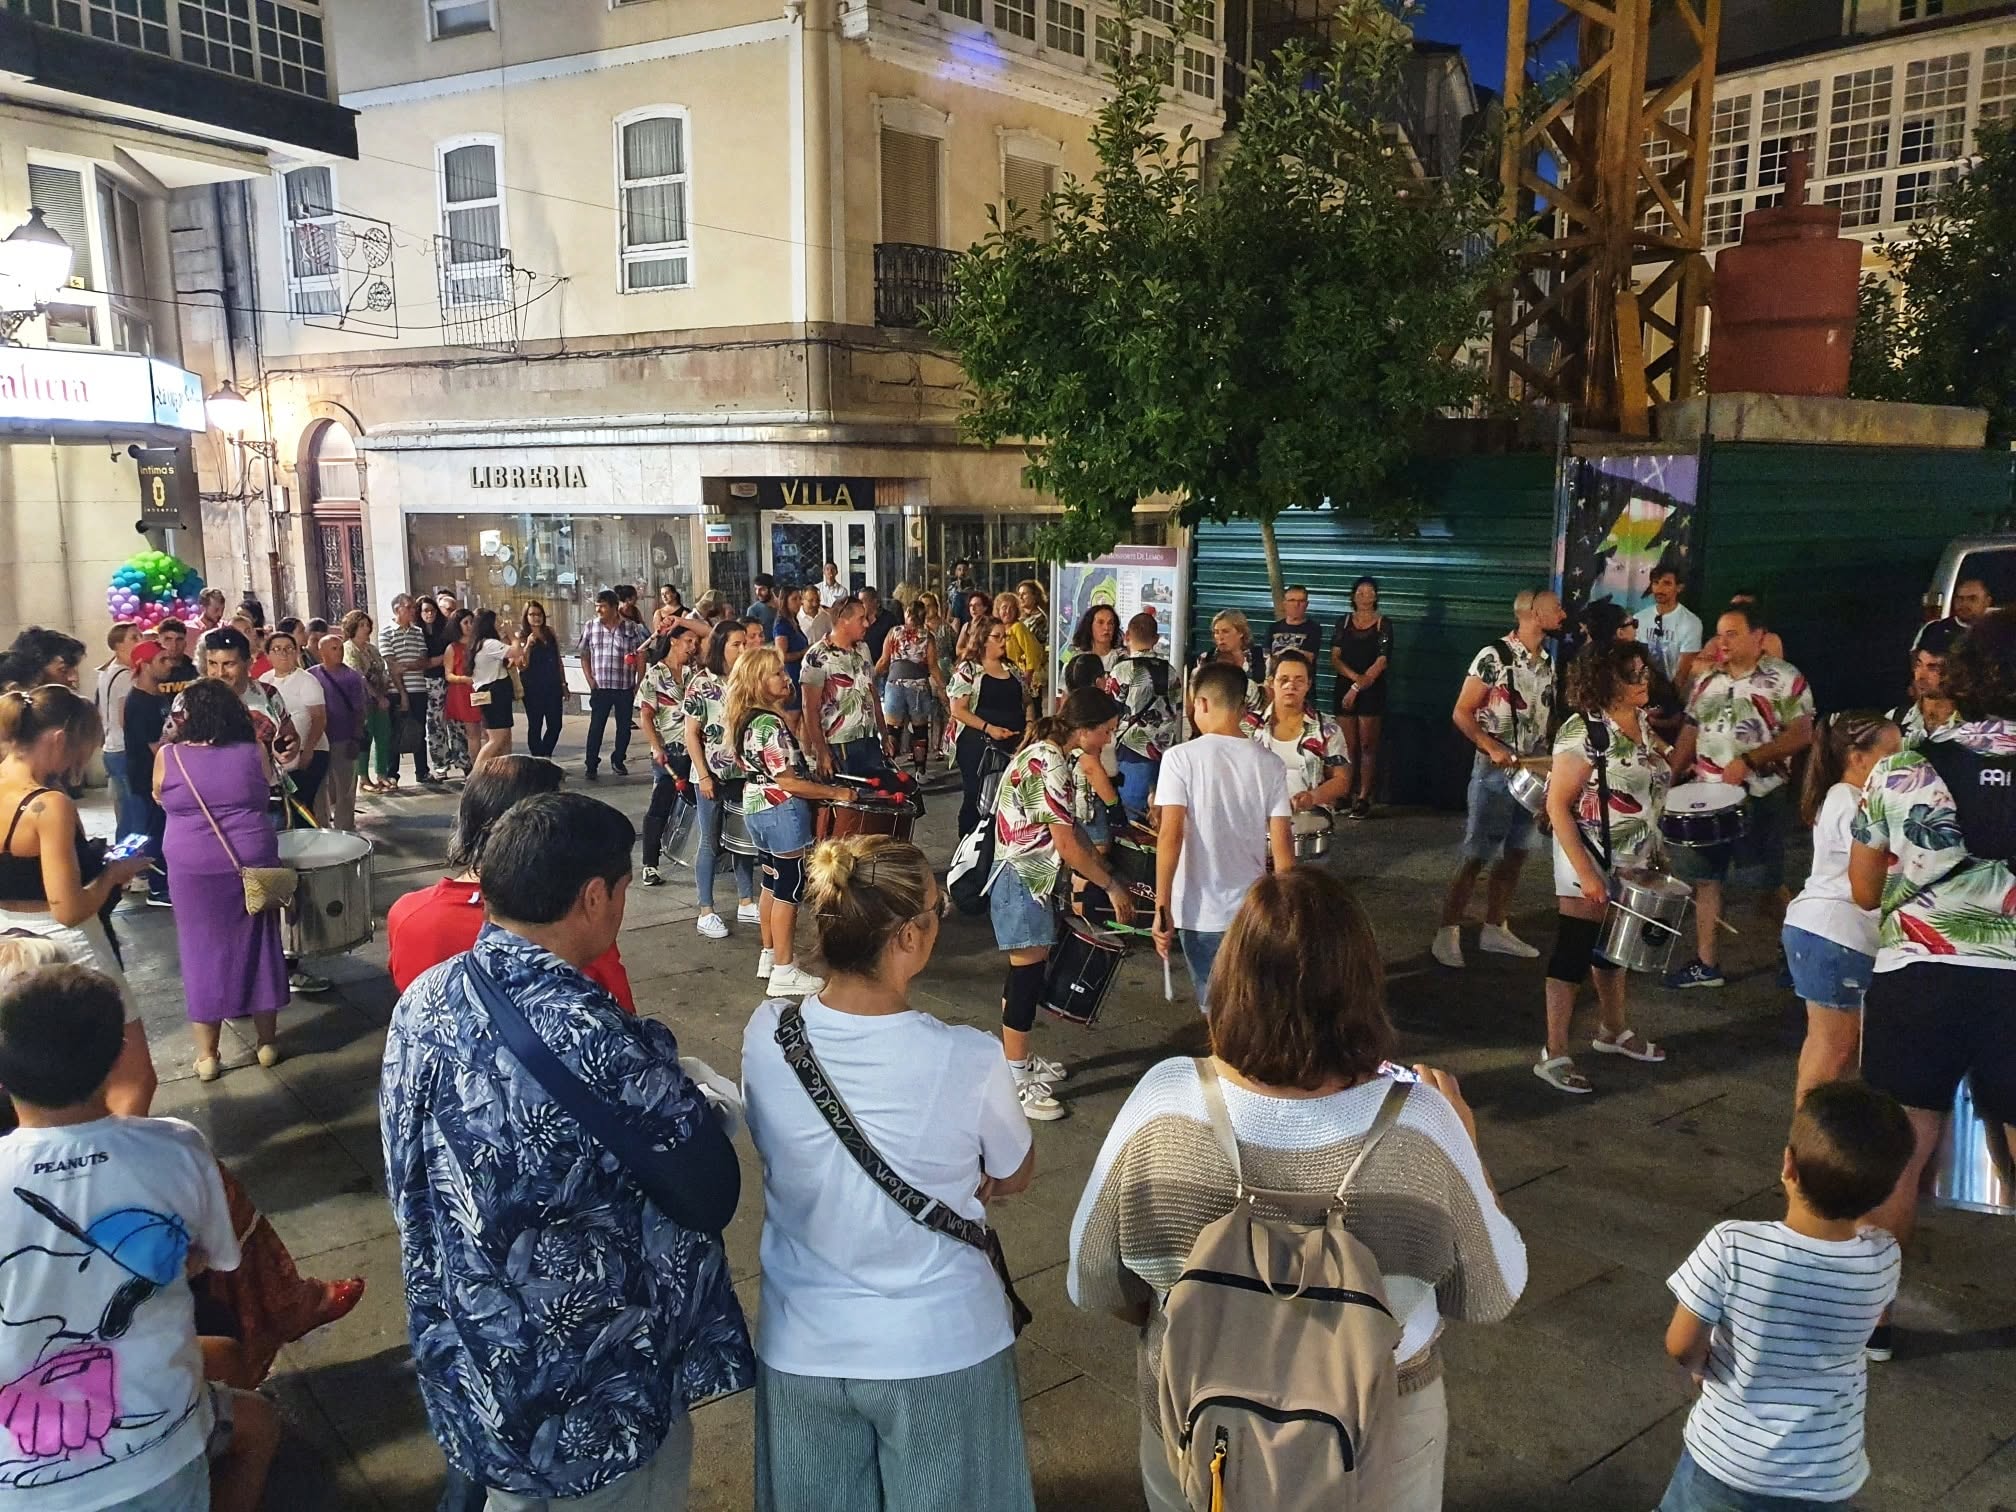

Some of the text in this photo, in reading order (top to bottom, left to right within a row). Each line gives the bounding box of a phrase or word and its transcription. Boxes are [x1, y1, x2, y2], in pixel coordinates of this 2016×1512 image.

[471, 465, 588, 489] LIBRERIA
[780, 479, 855, 511] VILA
[33, 1151, 109, 1175] PEANUTS
